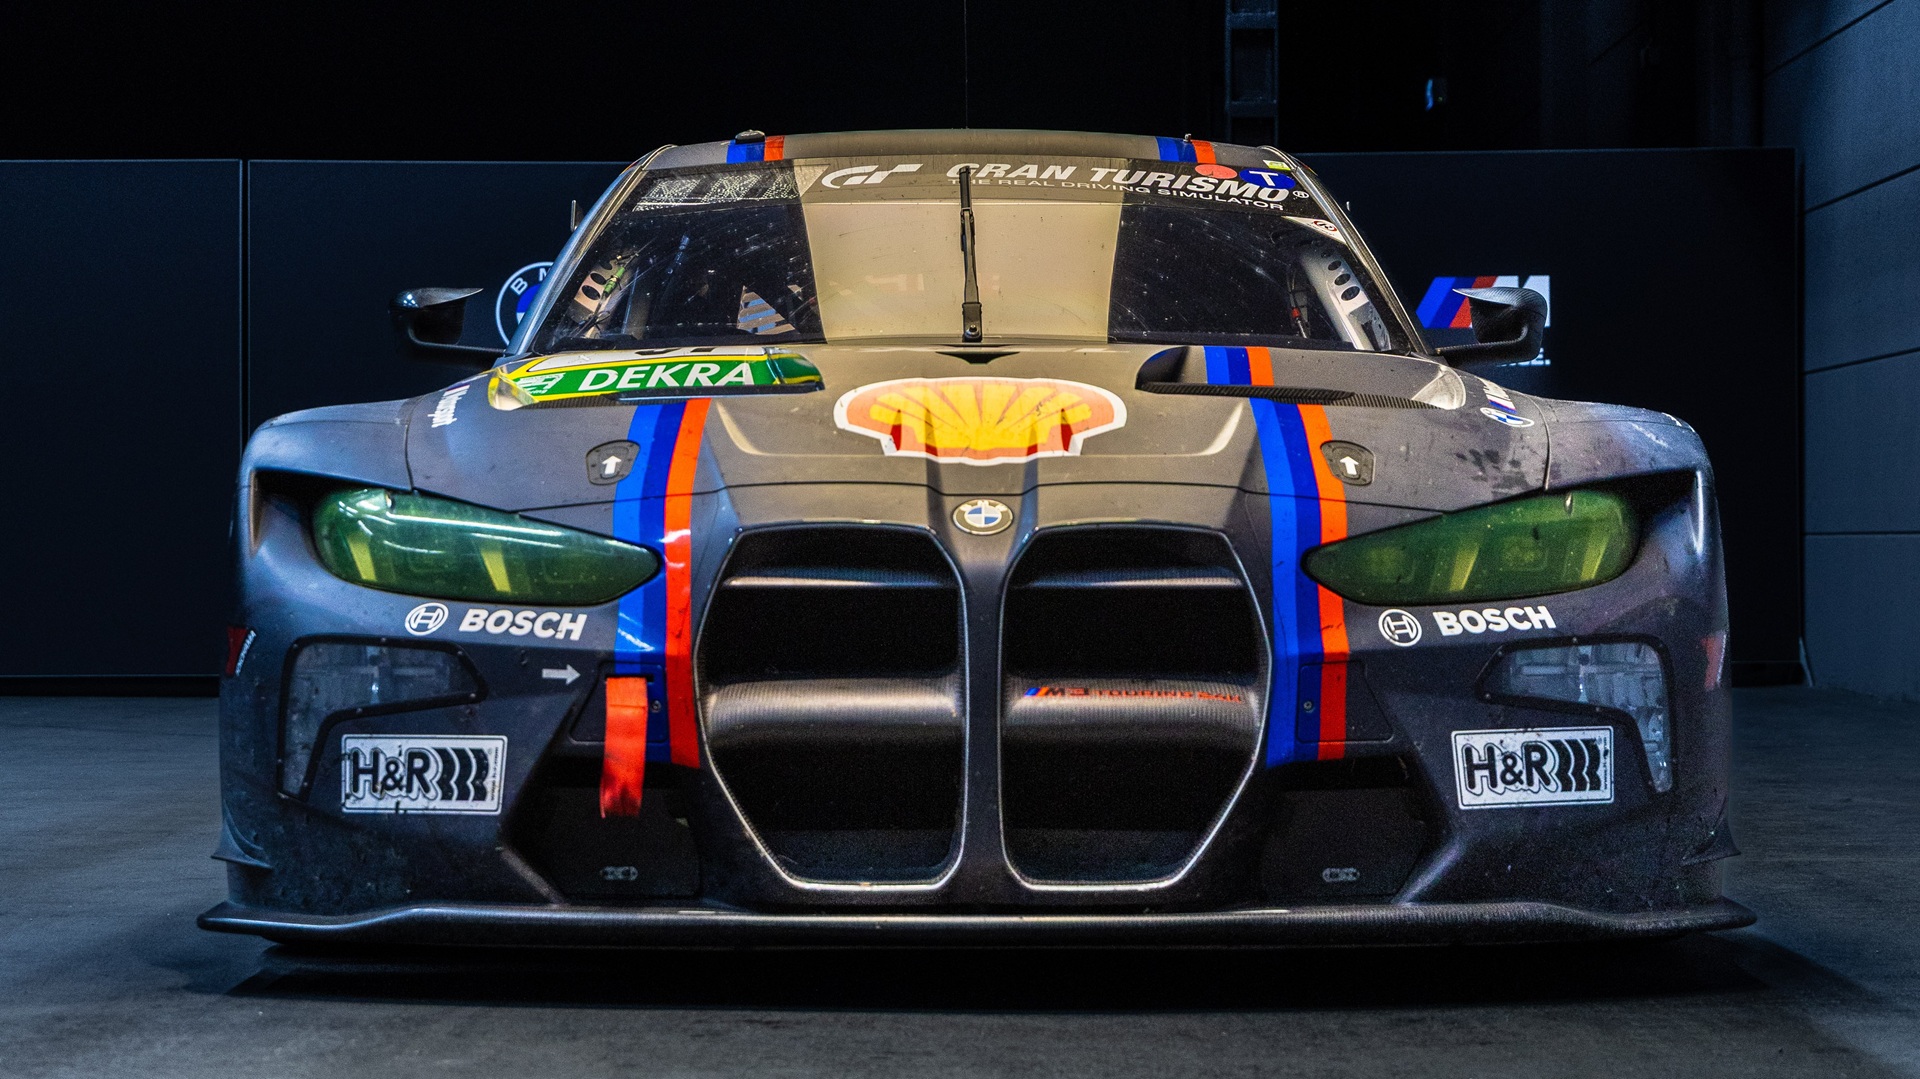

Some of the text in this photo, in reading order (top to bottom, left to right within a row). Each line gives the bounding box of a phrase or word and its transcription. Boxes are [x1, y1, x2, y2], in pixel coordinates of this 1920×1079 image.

[946, 162, 1077, 180] GRAN
[999, 179, 1053, 188] REAL
[1062, 181, 1151, 194] DRIVING
[1157, 187, 1284, 211] SIMULATOR
[578, 362, 755, 391] DEKRA
[458, 608, 587, 641] BOSCH
[1432, 605, 1557, 636] BOSCH
[351, 748, 434, 796] H&R
[1464, 743, 1552, 792] H&R
